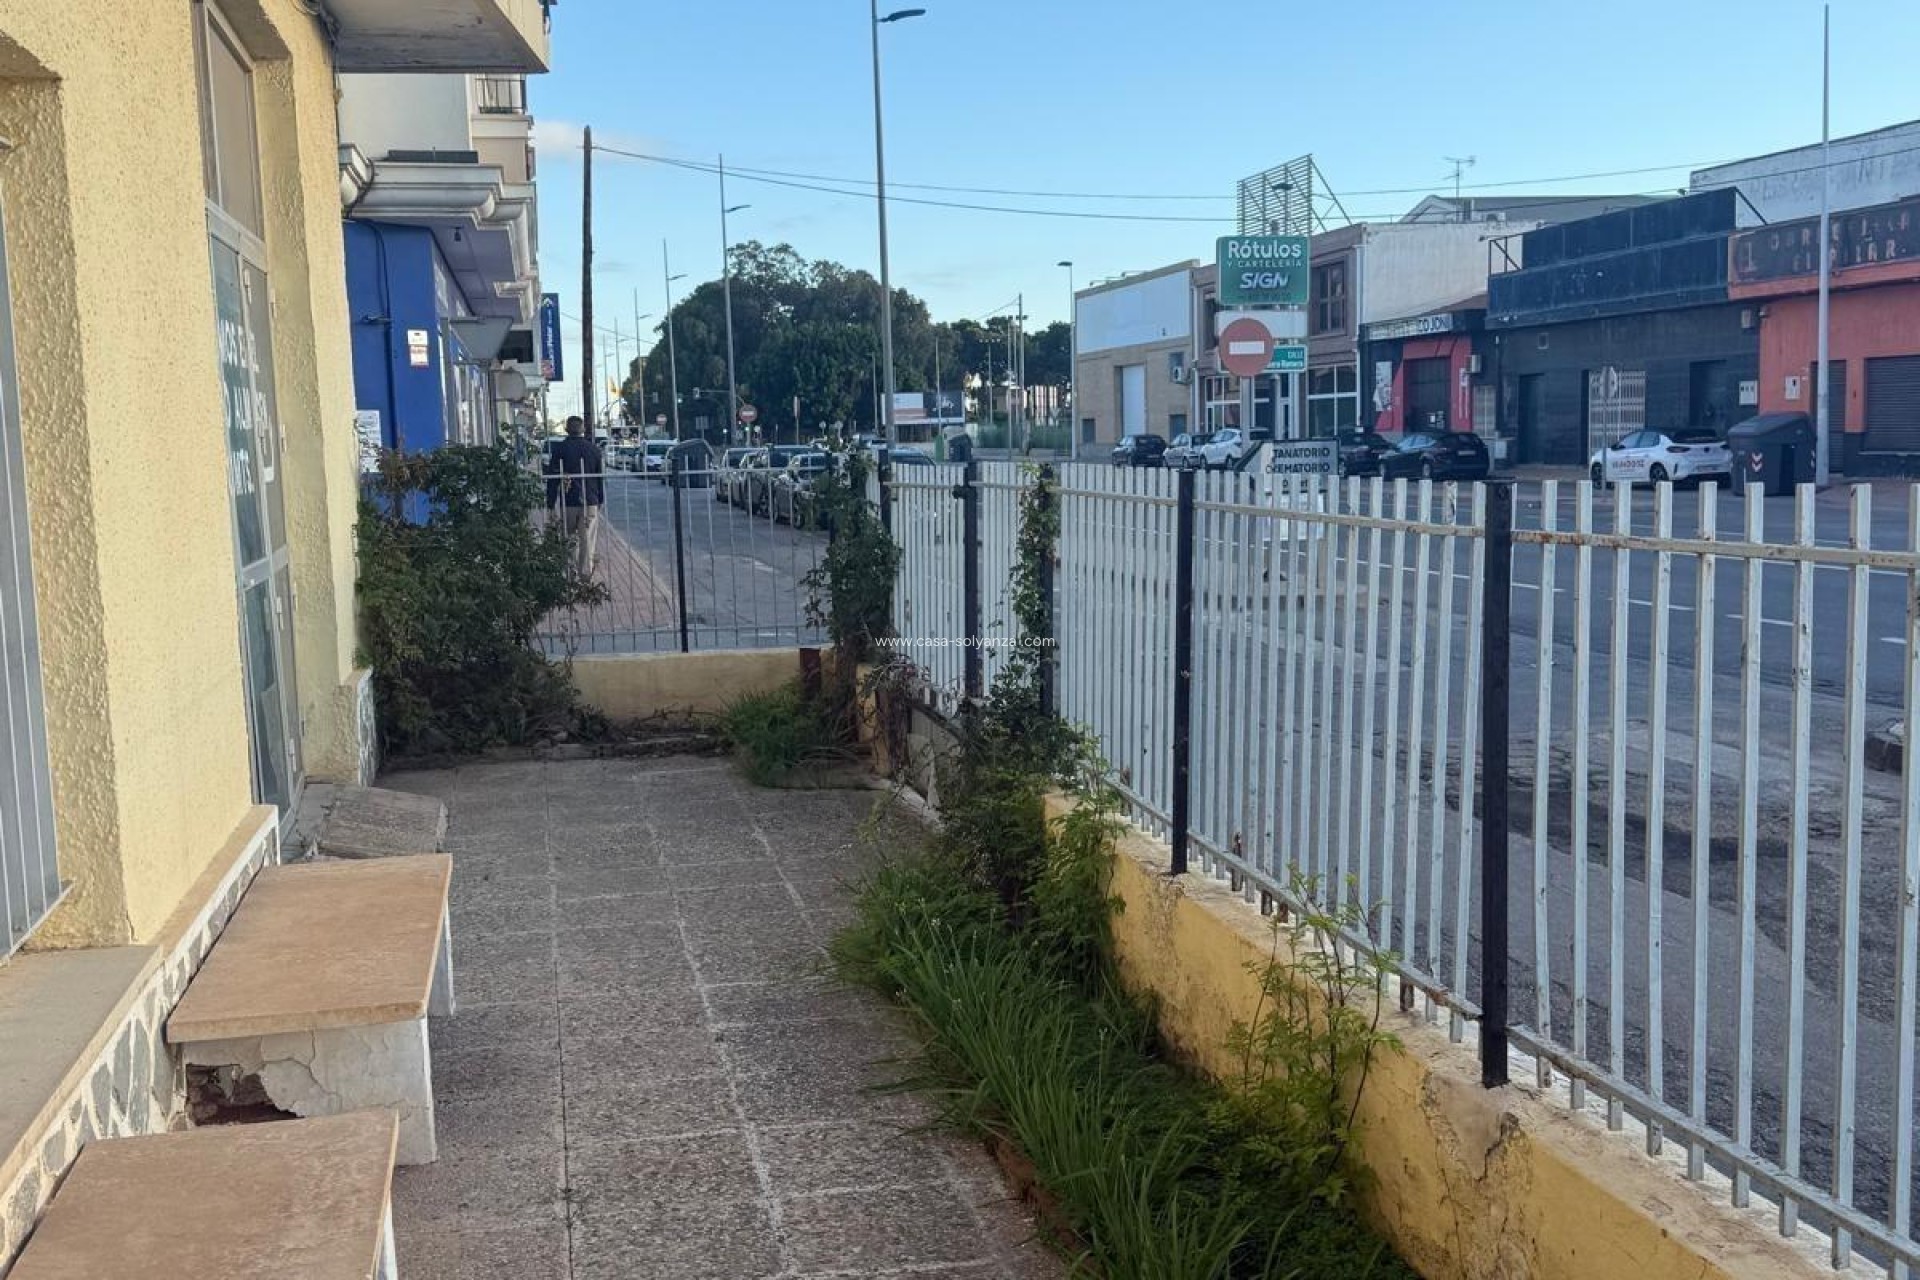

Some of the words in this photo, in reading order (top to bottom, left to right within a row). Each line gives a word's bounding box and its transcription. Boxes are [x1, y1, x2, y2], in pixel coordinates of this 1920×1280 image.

[1228, 239, 1302, 259] Rótulos
[1239, 272, 1289, 289] SIGN
[1272, 447, 1331, 458] TANATORIO
[1265, 461, 1331, 474] CREMATORIO
